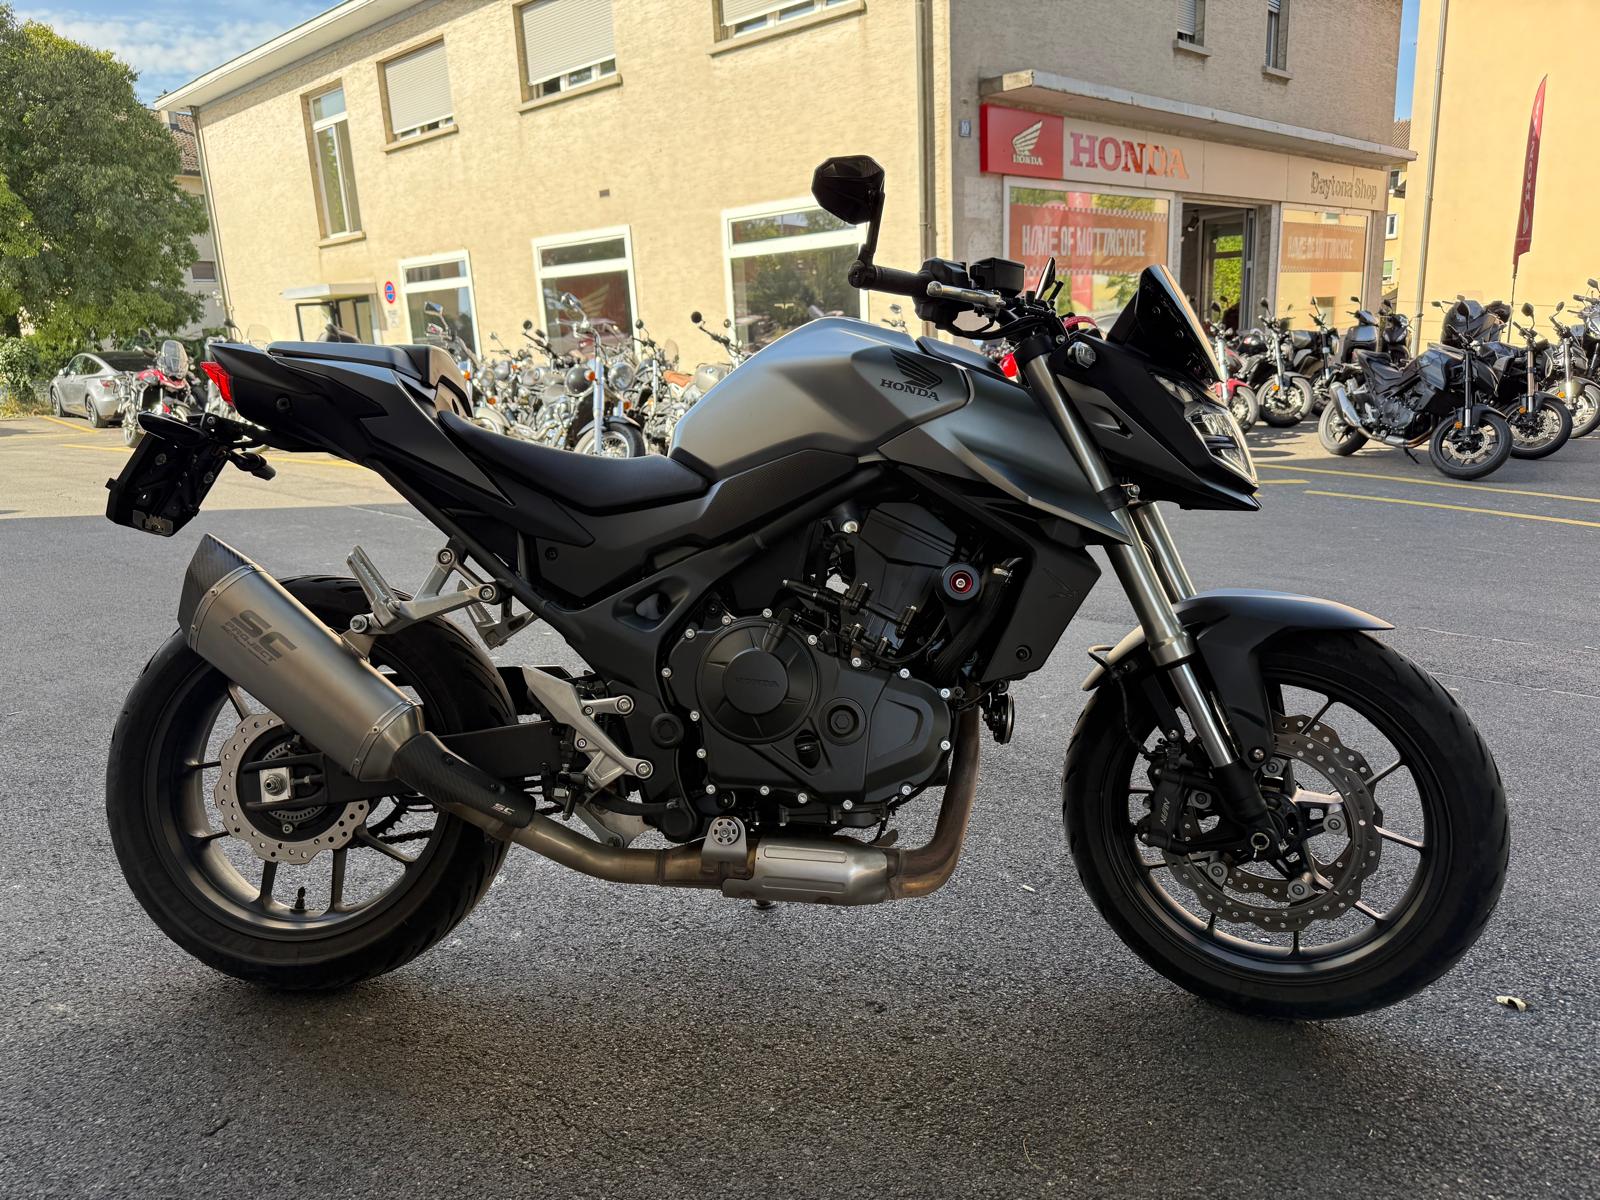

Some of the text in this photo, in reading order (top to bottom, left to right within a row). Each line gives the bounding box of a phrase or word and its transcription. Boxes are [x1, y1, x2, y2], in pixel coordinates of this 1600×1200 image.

[1012, 153, 1044, 166] HONDA
[1070, 131, 1189, 179] HONDA
[1310, 170, 1377, 204] Daytona Shop
[1021, 224, 1059, 257] HOME
[1060, 225, 1075, 257] OF
[880, 378, 940, 402] HONDA
[230, 609, 298, 660] SC
